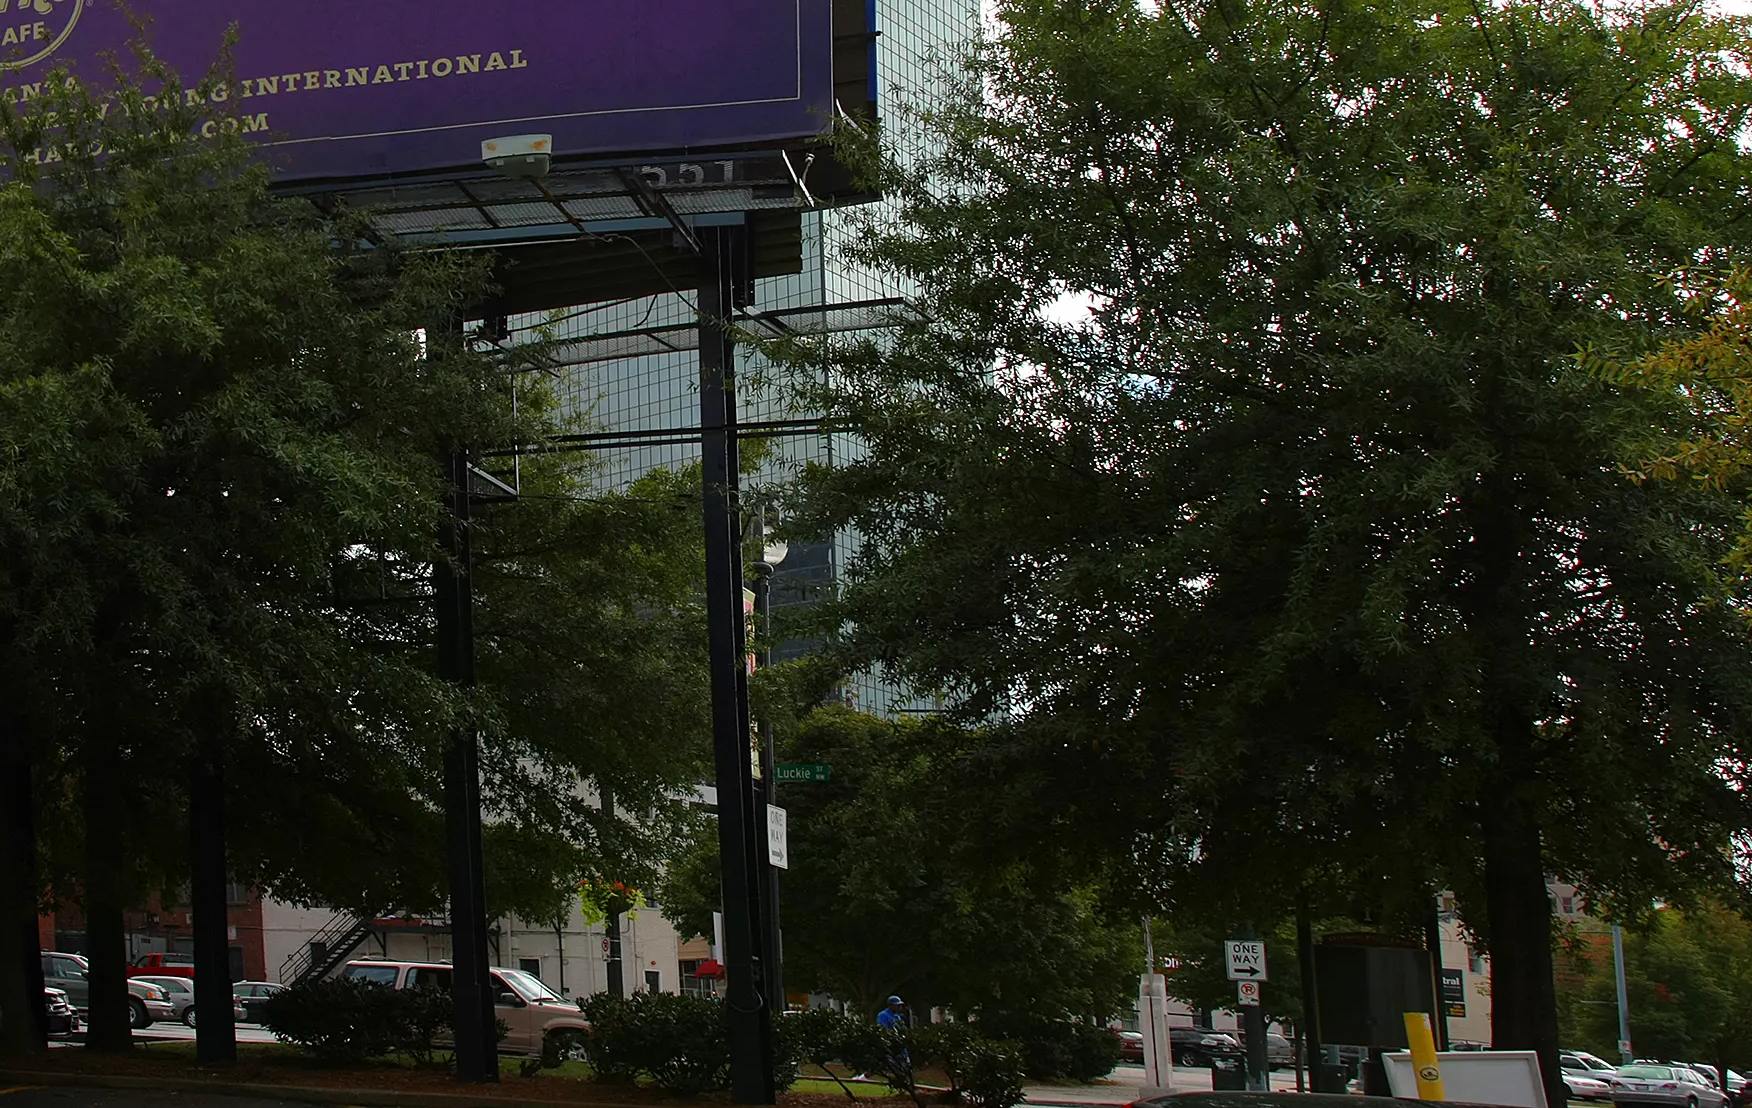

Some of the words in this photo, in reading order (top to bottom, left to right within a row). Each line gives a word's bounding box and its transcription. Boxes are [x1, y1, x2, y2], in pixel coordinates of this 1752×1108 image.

[241, 49, 528, 98] INTERNATIONAL
[777, 768, 811, 779] Luckie
[771, 811, 783, 827] ONE
[1233, 944, 1259, 954] ONE
[1232, 954, 1259, 964] WAY
